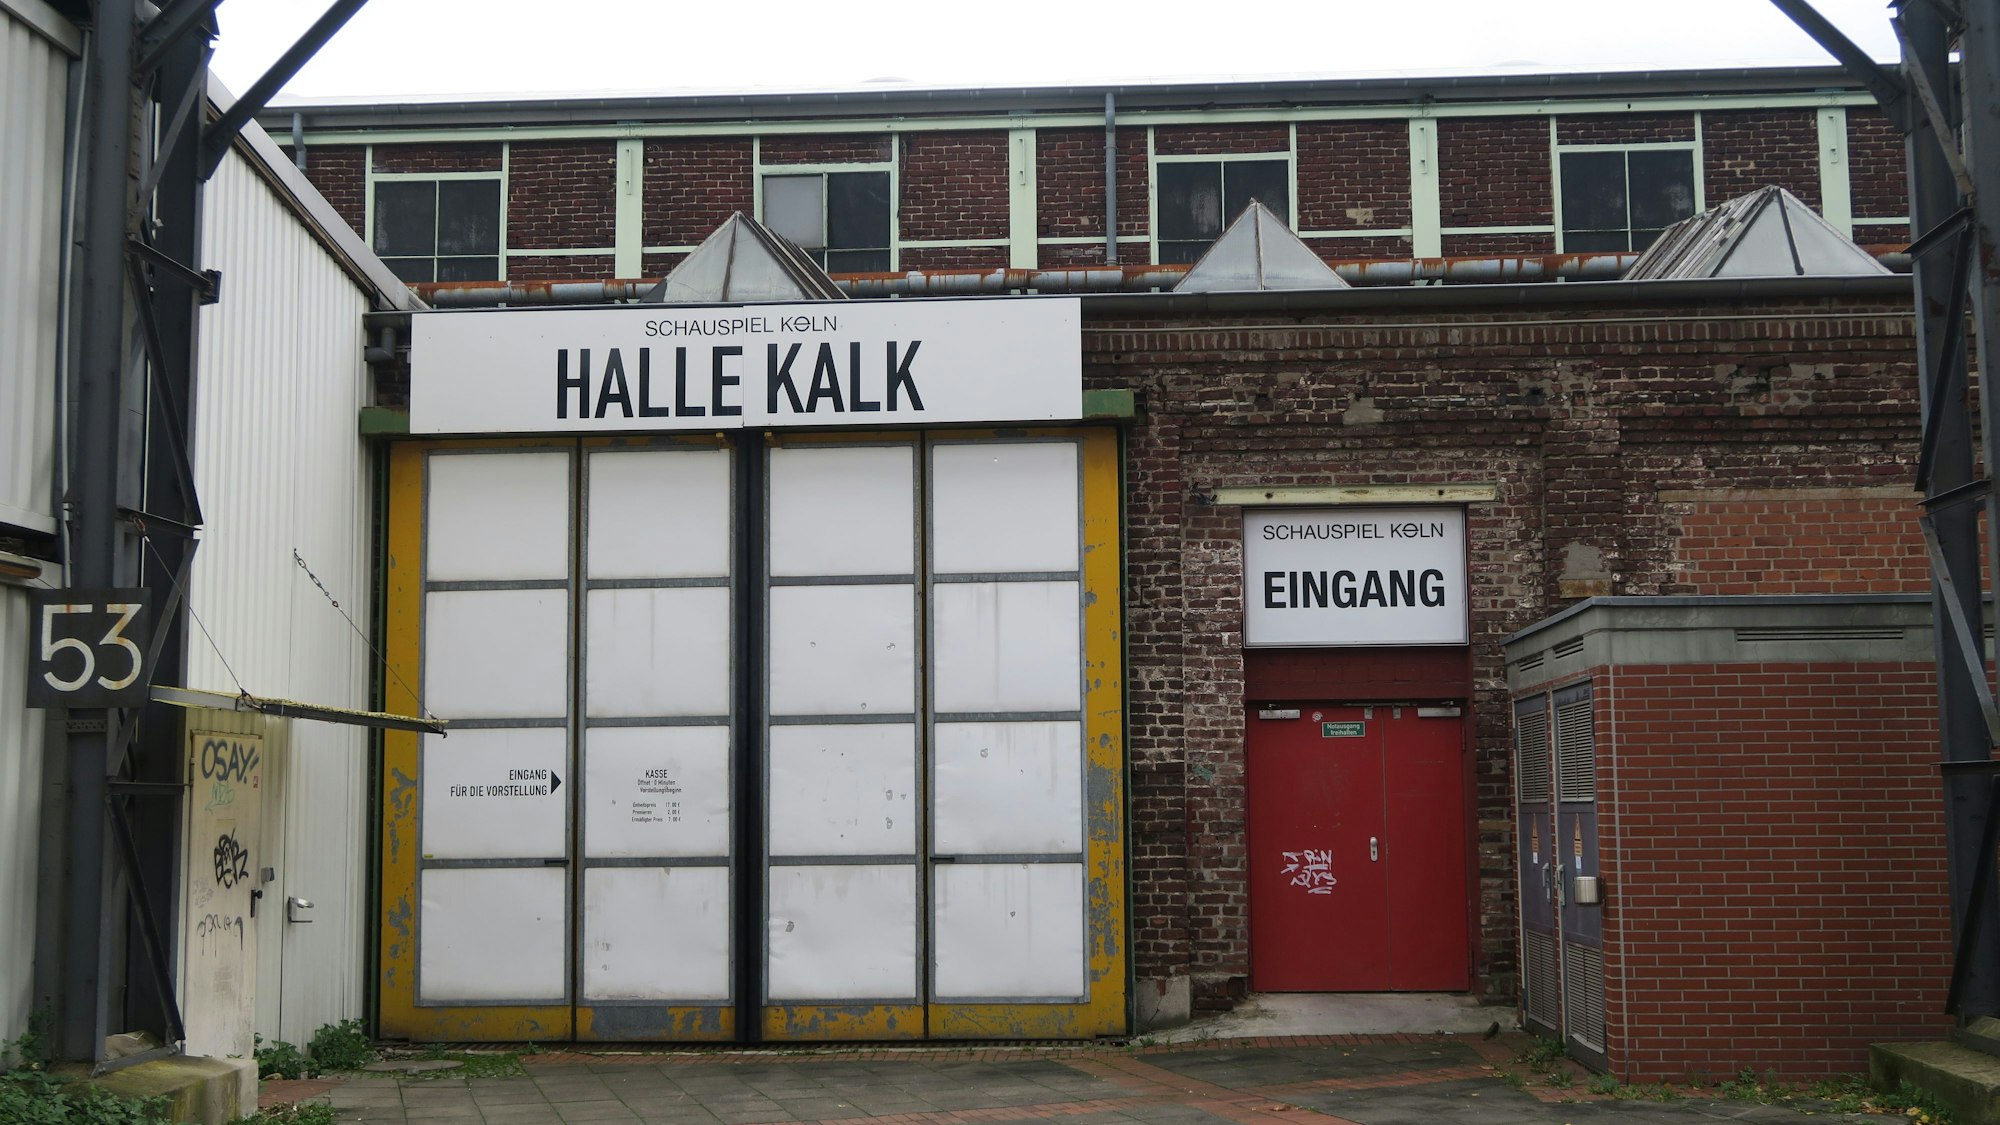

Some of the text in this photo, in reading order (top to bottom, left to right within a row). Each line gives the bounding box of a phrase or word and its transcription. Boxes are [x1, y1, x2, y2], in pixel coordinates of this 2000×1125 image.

[645, 317, 774, 337] SCHAUSPIEL
[555, 340, 925, 419] HALLE KALK
[1262, 523, 1384, 540] SCHAUSPIEL
[1264, 569, 1445, 609] EINGANG
[41, 603, 142, 691] 53
[509, 769, 547, 780] EINGANG
[645, 769, 668, 779] KASSE
[450, 784, 548, 797] FÜR DIE VORSTELLUNG
